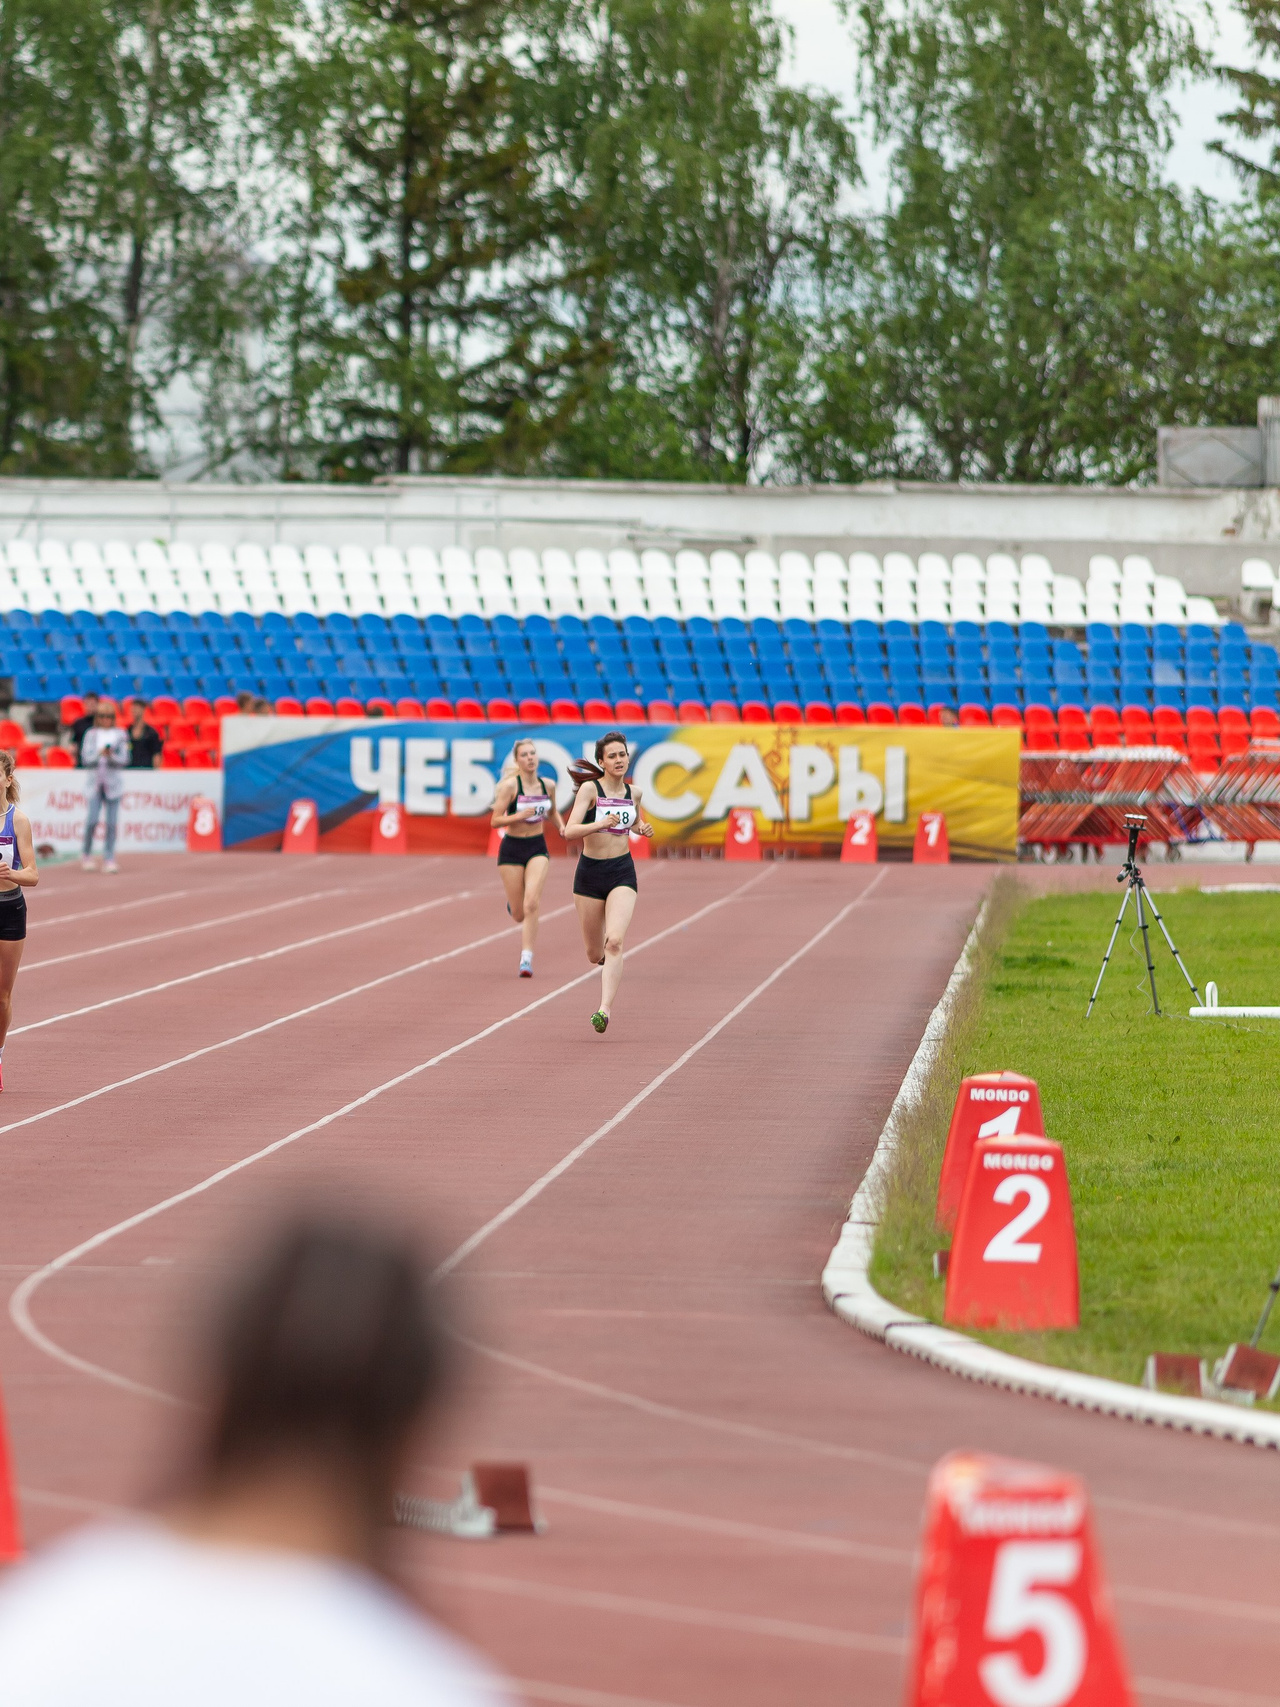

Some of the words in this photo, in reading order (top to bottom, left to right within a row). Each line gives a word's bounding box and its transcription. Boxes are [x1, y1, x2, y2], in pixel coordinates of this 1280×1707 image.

[194, 808, 214, 836] 8
[292, 805, 312, 836] 7
[380, 809, 401, 838] 6
[732, 819, 754, 845] 3
[850, 819, 872, 845] 2
[924, 820, 941, 847] 1
[970, 1087, 1030, 1103] MONDO
[983, 1153, 1054, 1171] MONDO
[982, 1173, 1051, 1263] 2
[978, 1540, 1089, 1707] 5
